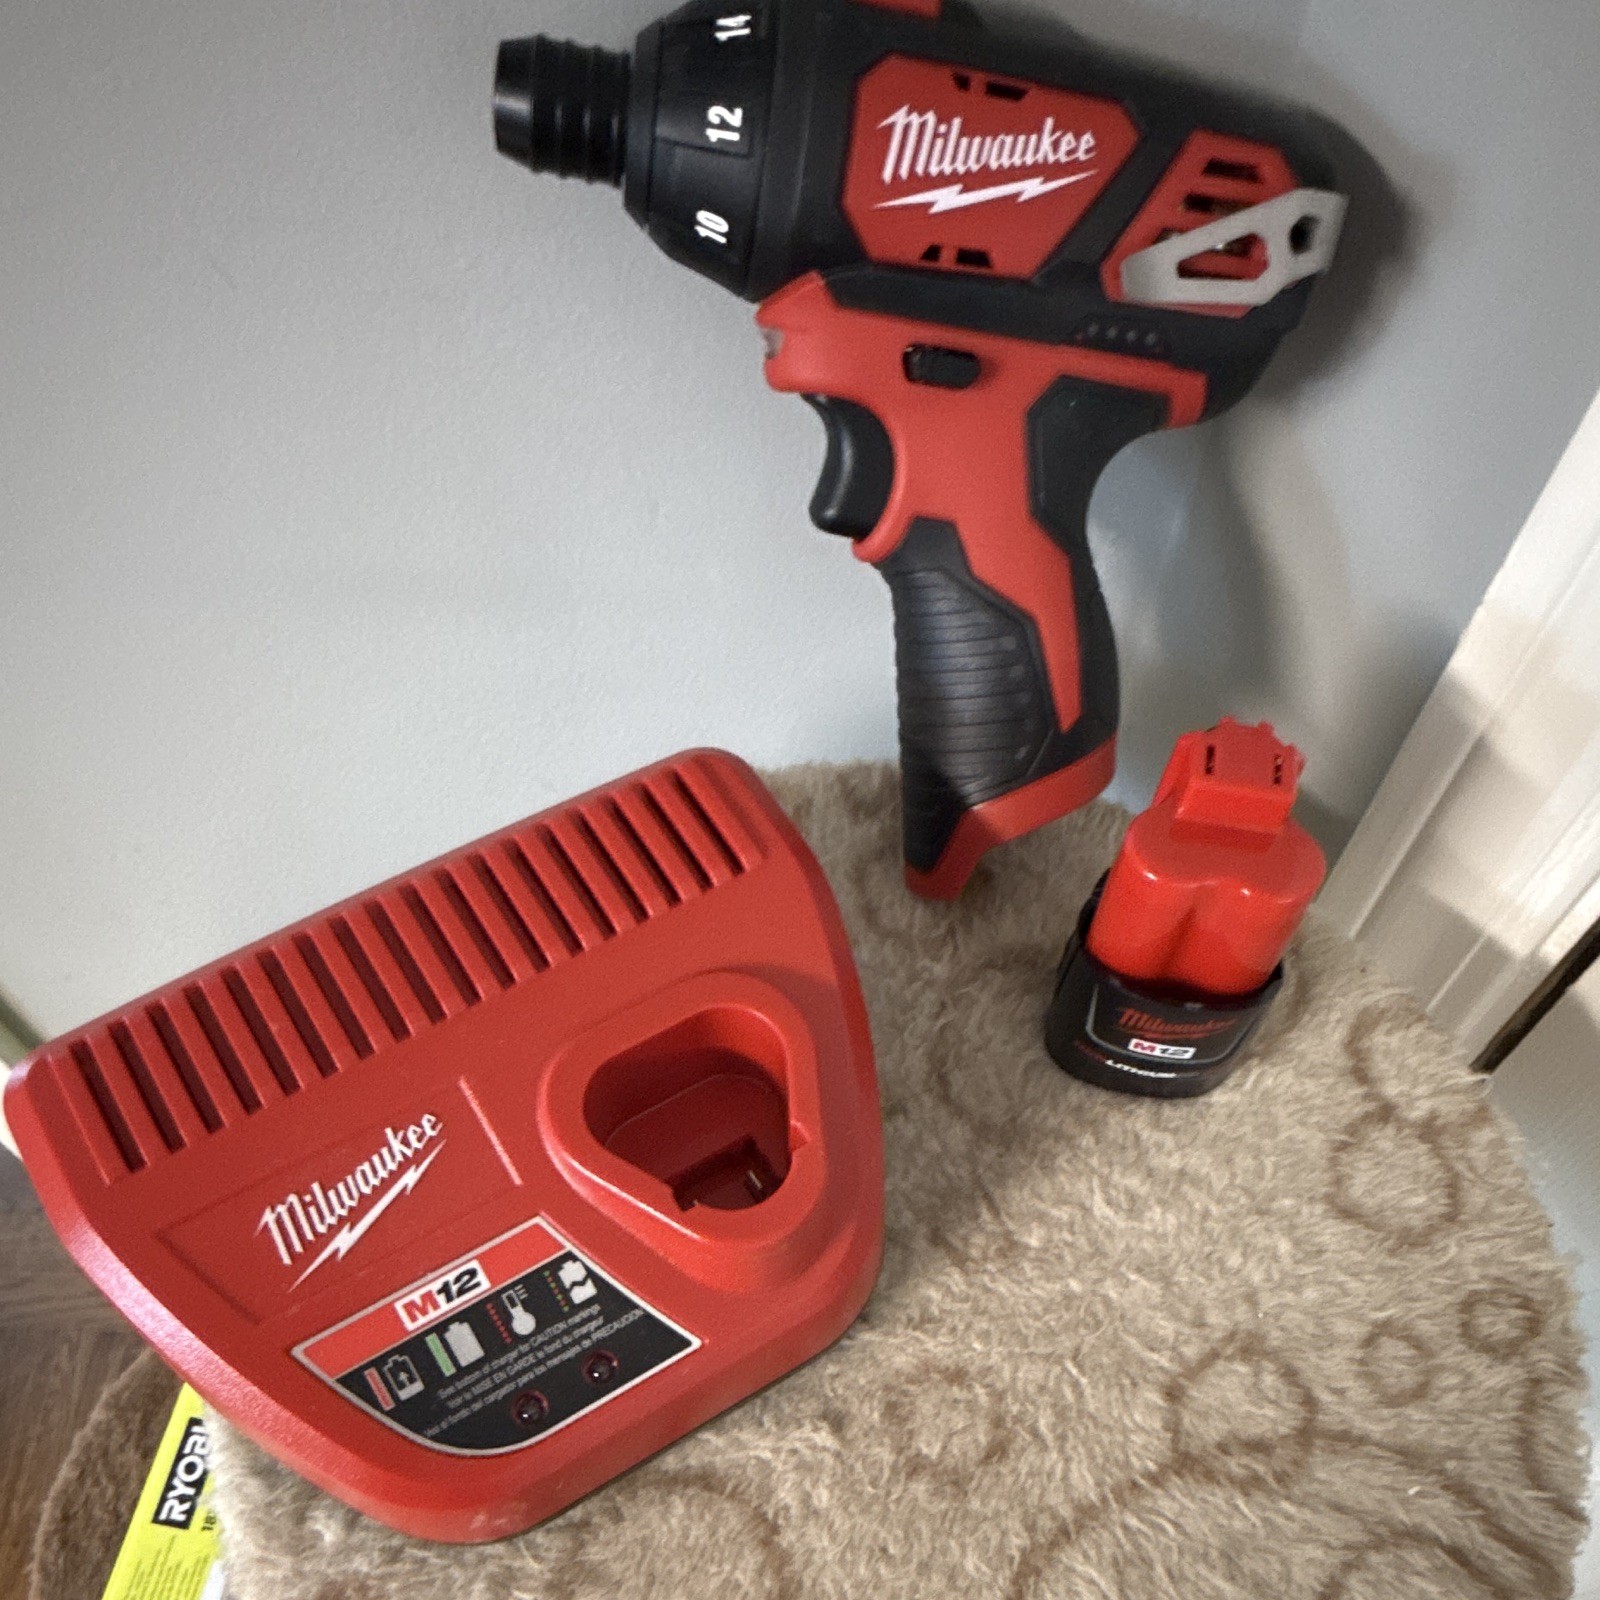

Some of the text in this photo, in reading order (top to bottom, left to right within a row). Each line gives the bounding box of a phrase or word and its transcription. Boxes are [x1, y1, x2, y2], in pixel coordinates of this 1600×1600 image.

[715, 14, 752, 41] 14
[706, 105, 743, 143] 12
[877, 104, 1097, 185] Milwaukee
[694, 210, 729, 244] 10
[1133, 1042, 1190, 1057] M12
[254, 1113, 444, 1266] Milwaukee
[401, 1267, 482, 1324] M12
